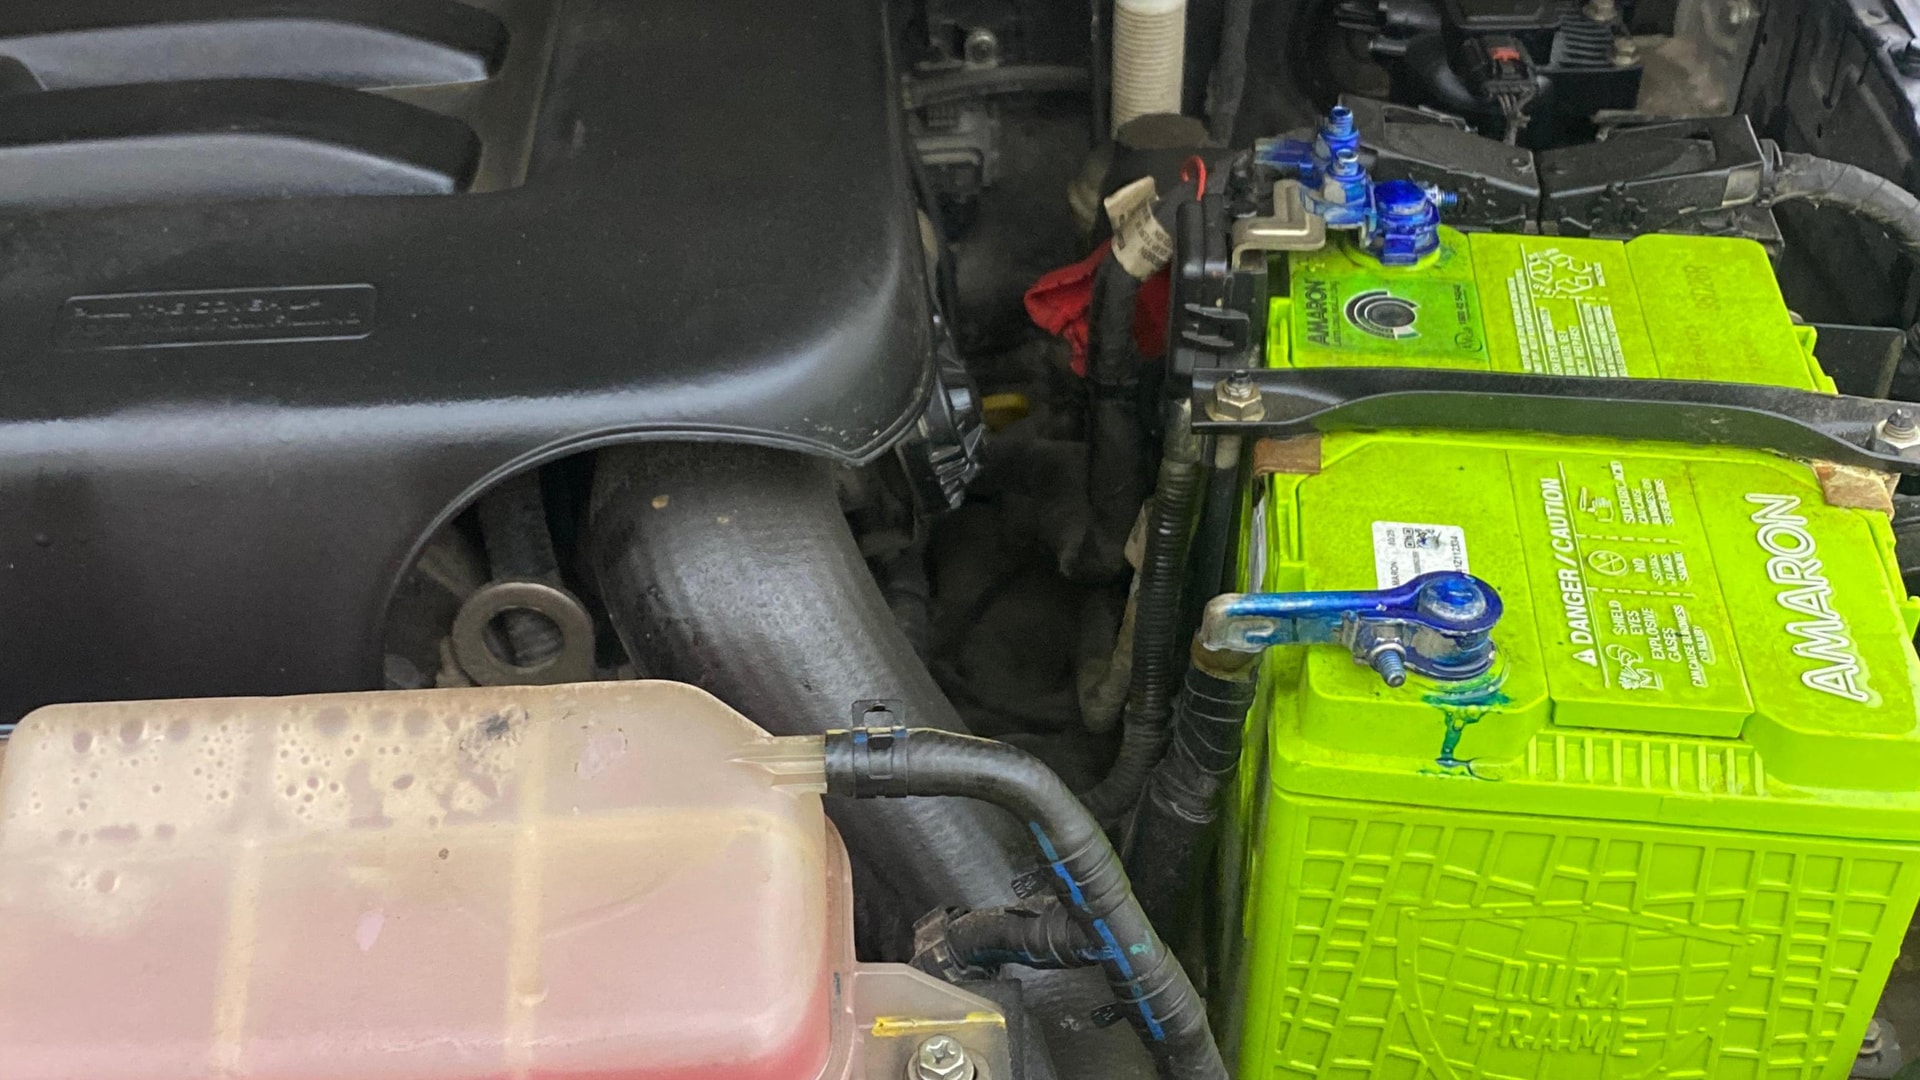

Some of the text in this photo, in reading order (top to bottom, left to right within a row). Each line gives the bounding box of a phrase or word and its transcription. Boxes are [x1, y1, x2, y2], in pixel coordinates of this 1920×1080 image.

[1303, 278, 1330, 347] AMARON
[1540, 478, 1574, 551] CAUTION
[1390, 561, 1399, 586] MARON
[1632, 558, 1646, 573] NO
[1558, 568, 1594, 644] DANGER
[1609, 600, 1627, 635] SHIELD
[1745, 493, 1872, 704] AMARON
[1626, 610, 1644, 636] EYES
[1641, 607, 1665, 660] EXPLOSIVE
[1662, 628, 1681, 662] GASES
[1673, 604, 1693, 644] BLINDNESS
[1684, 645, 1701, 669] CAUSE
[1499, 957, 1628, 1009] DURA
[1466, 1004, 1647, 1057] FRAME
